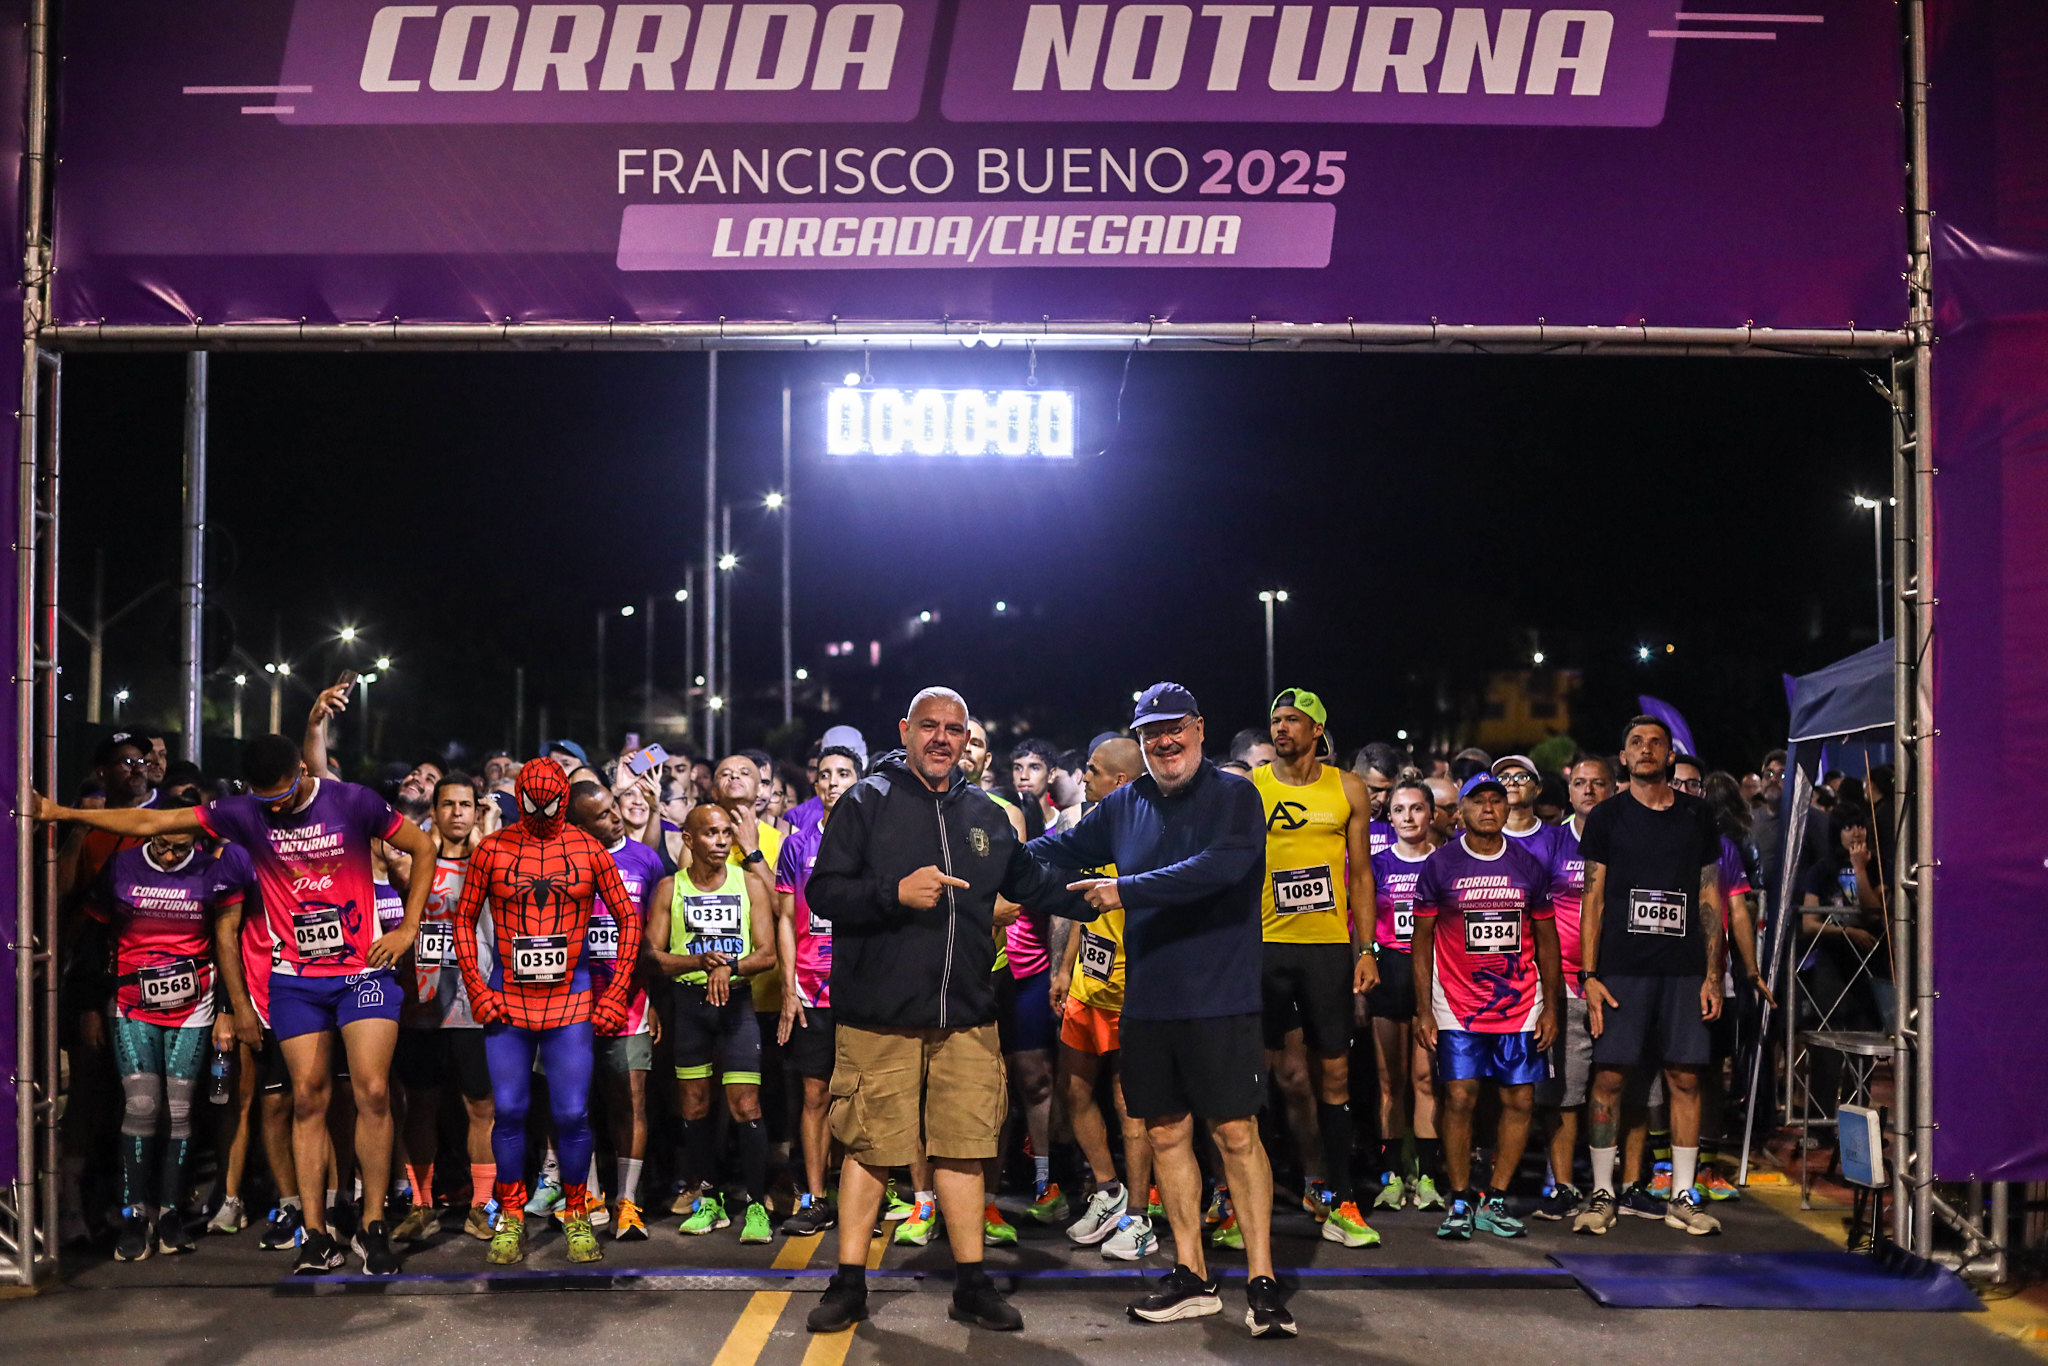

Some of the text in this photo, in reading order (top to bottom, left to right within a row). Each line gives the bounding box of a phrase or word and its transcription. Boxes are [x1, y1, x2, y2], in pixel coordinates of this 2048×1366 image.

[359, 4, 1614, 96] CORRIDA NOTURNA
[618, 146, 1347, 196] FRANCISCO BUENO 2025
[712, 214, 1242, 263] LARGADA/CHEGADA
[270, 823, 322, 841] CORRIDA
[278, 833, 338, 854] NOTURNA
[1282, 881, 1324, 900] 1089
[1456, 876, 1508, 890] CORRIDA
[131, 885, 187, 900] CORRIDA
[1464, 887, 1521, 901] NOTURNA
[139, 898, 199, 912] NOTURNA
[1637, 904, 1678, 921] 0686
[692, 908, 732, 922] 0331
[296, 925, 339, 944] 0540
[1472, 924, 1514, 939] 0384
[520, 951, 565, 967] 0350
[148, 976, 192, 996] 0568
